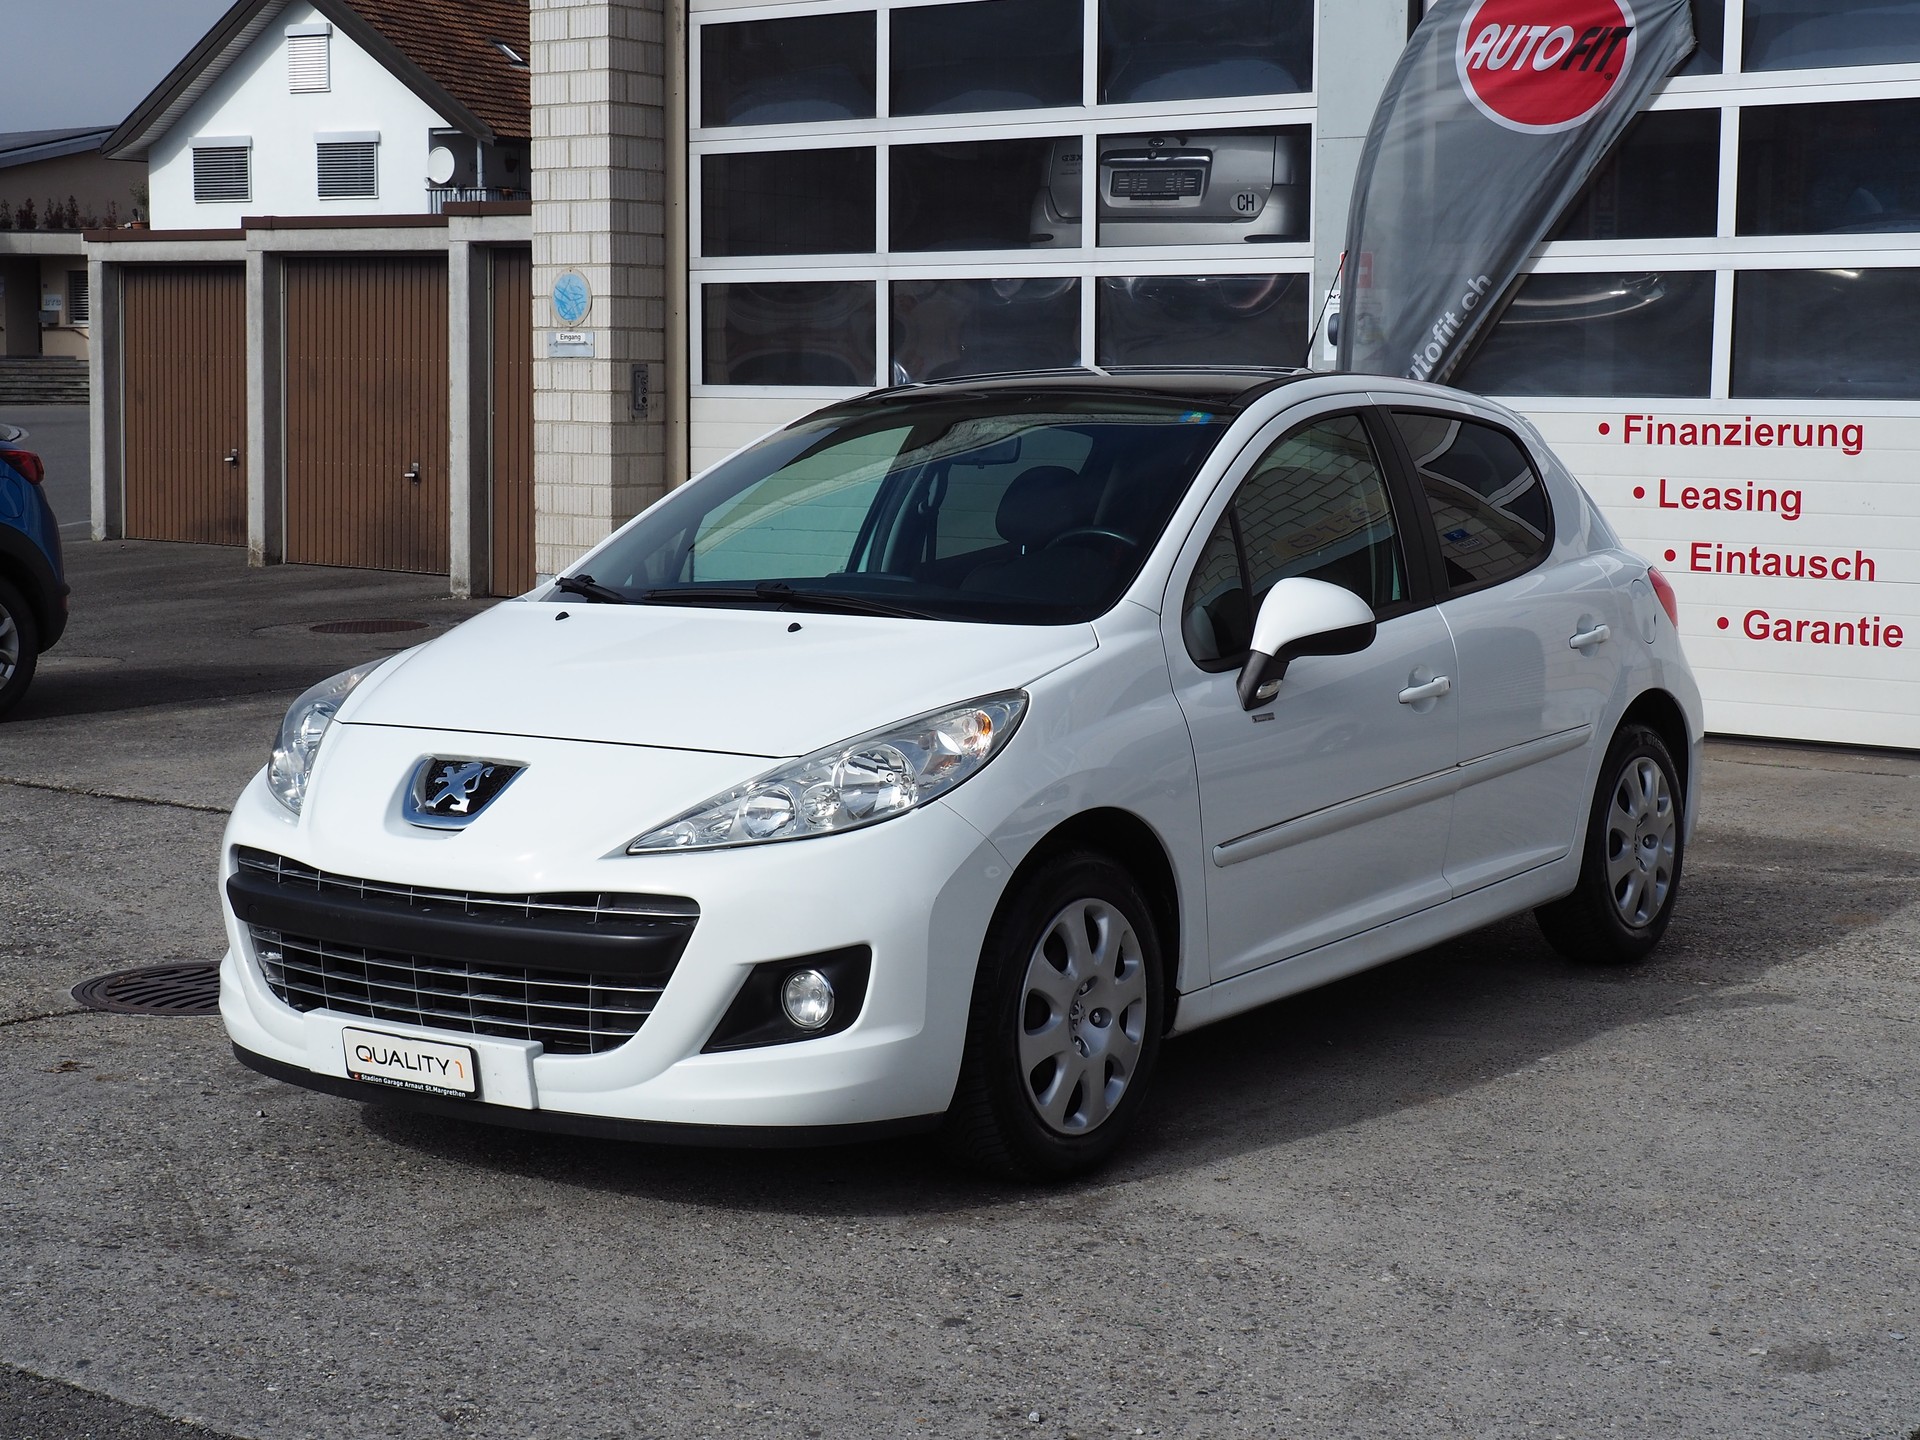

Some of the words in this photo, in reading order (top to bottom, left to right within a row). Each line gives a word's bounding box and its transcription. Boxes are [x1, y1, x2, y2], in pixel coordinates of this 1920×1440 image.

[1466, 23, 1634, 71] AUTOFIT
[1237, 194, 1254, 211] CH
[560, 333, 581, 342] Eingang
[1406, 275, 1492, 381] utofit.ch
[1623, 415, 1864, 455] Finanzierung
[1659, 479, 1802, 521] Leasing
[1690, 542, 1875, 581] Eintausch
[1743, 609, 1904, 648] Garantie
[355, 1045, 450, 1075] QUALITY
[361, 1073, 382, 1083] Stadion
[383, 1078, 403, 1087] Garage
[404, 1081, 424, 1090] Arnaut
